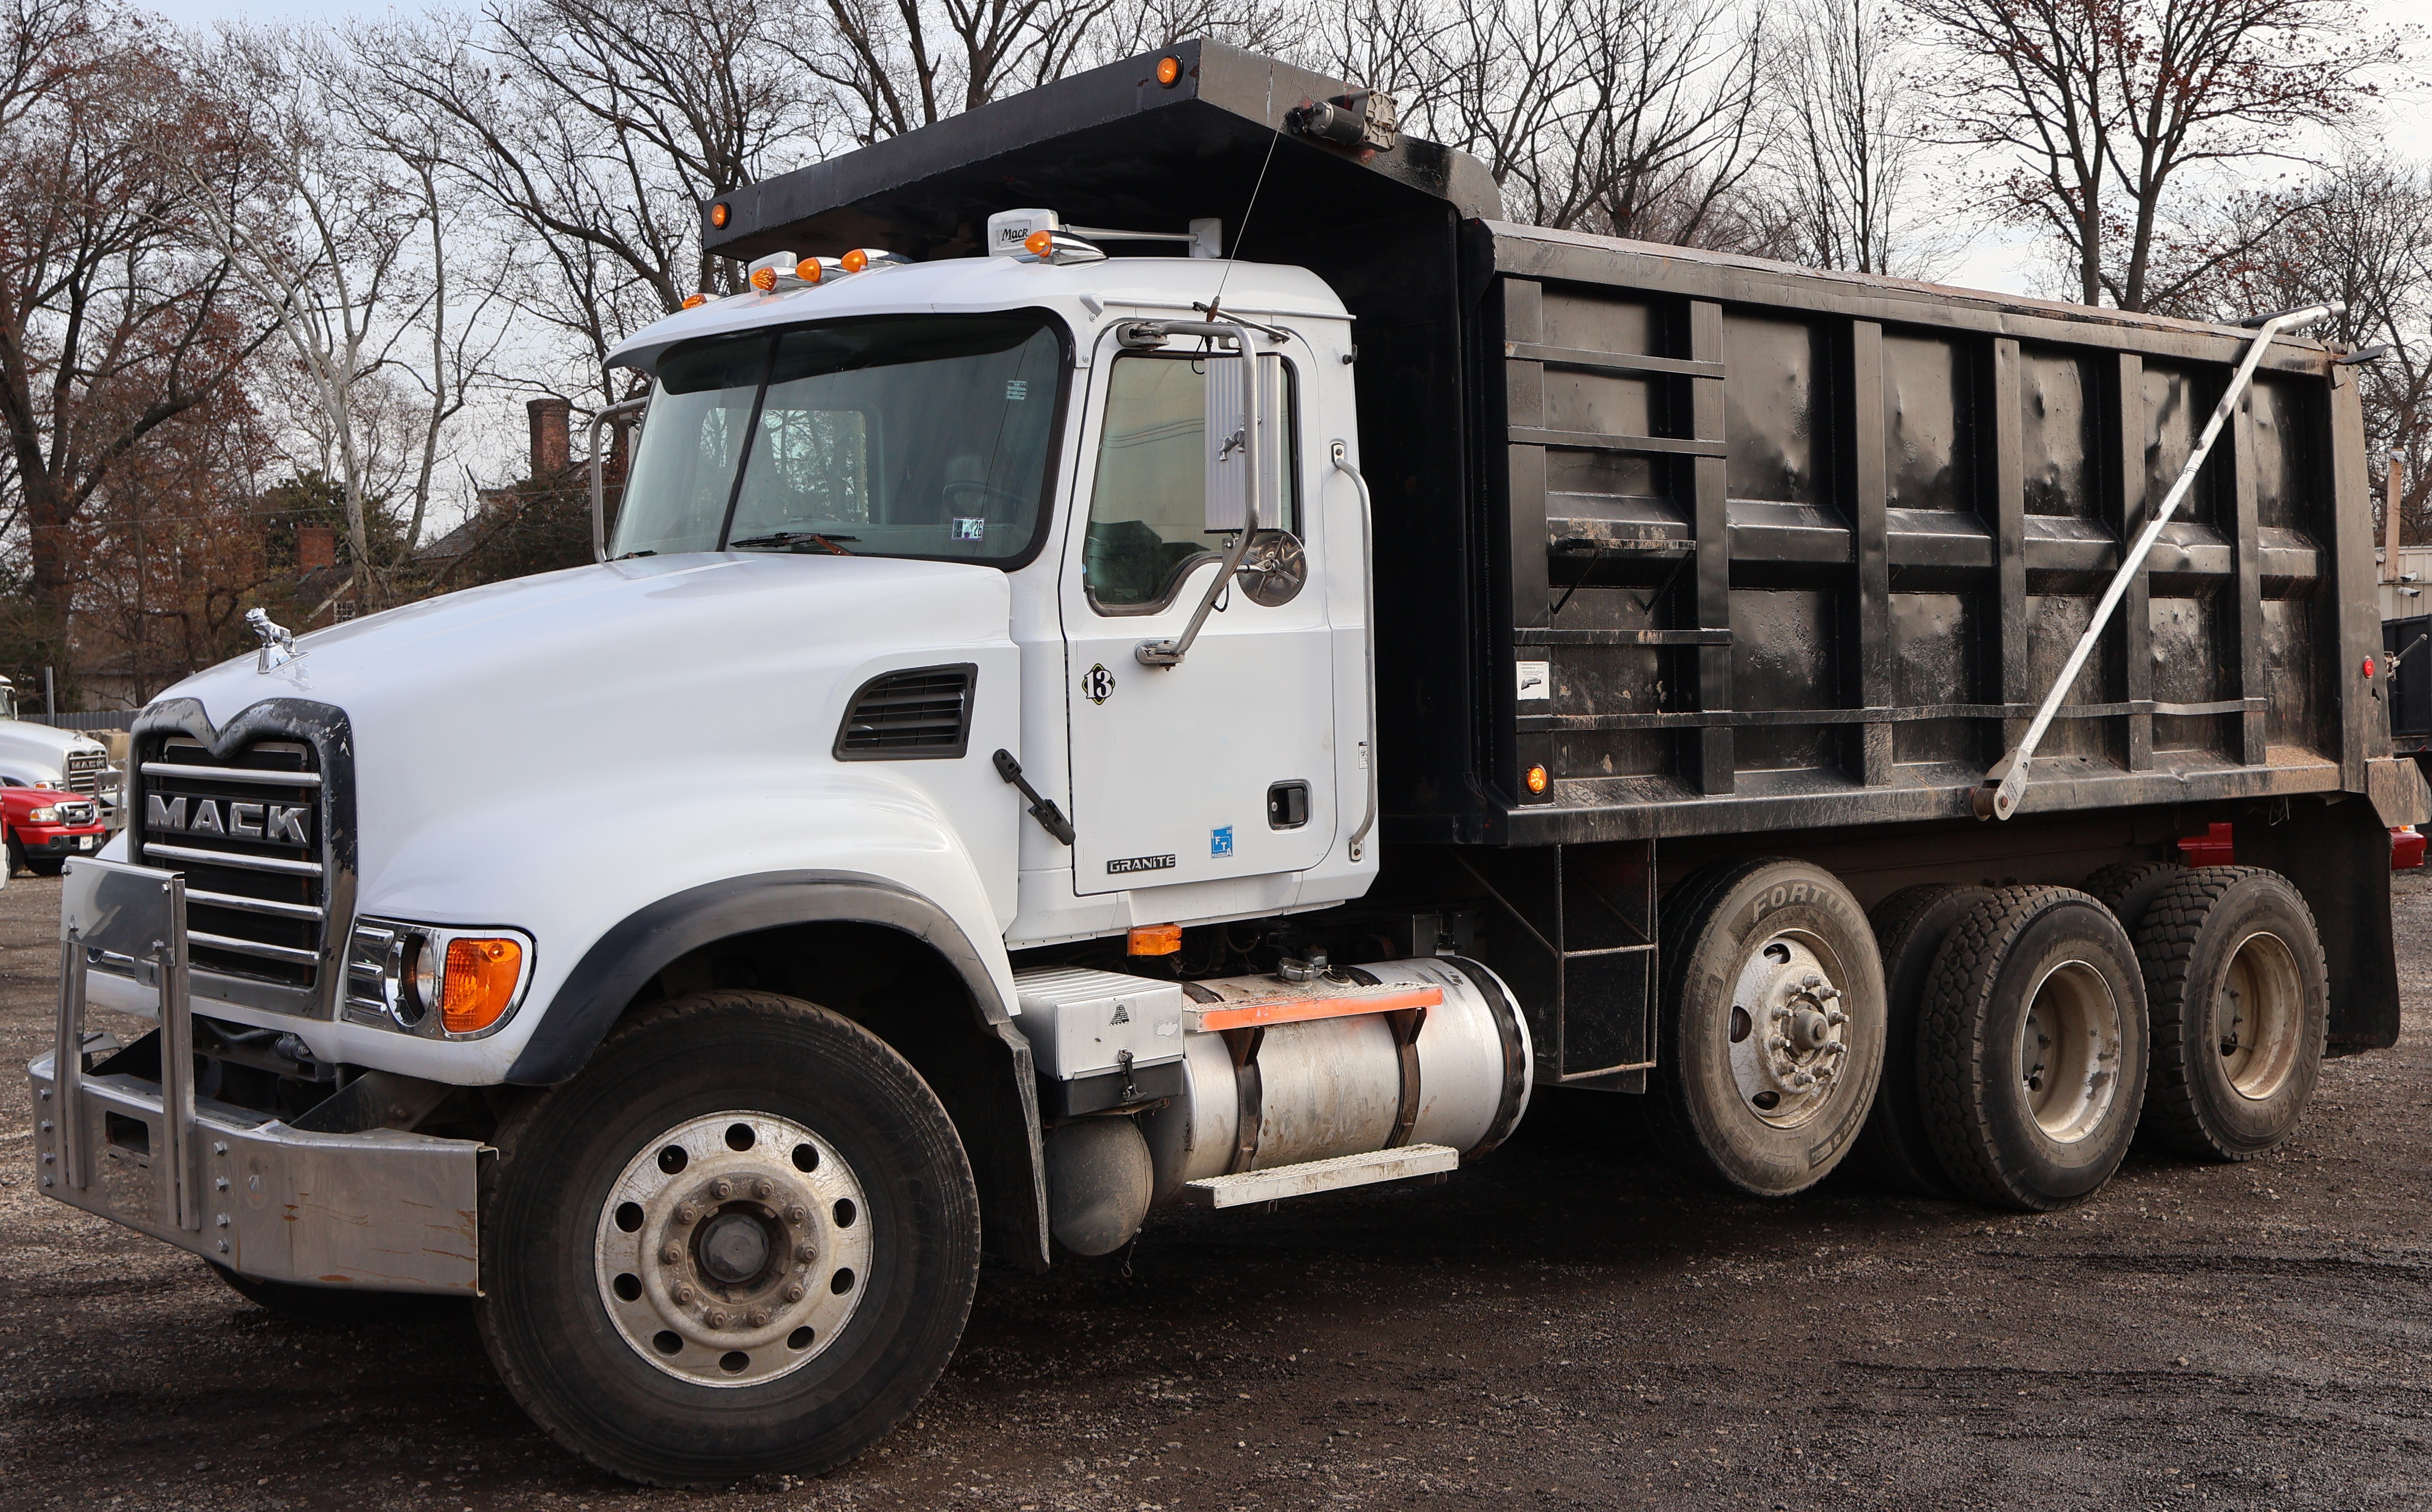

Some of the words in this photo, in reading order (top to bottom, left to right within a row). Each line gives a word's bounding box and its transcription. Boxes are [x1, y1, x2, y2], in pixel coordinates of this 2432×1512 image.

[974, 521, 983, 537] 26
[1085, 670, 1113, 698] 13
[71, 760, 106, 770] MACK
[147, 794, 307, 844] MACK
[1110, 856, 1175, 873] GRANITE
[1753, 883, 1871, 953] FORTUNE
